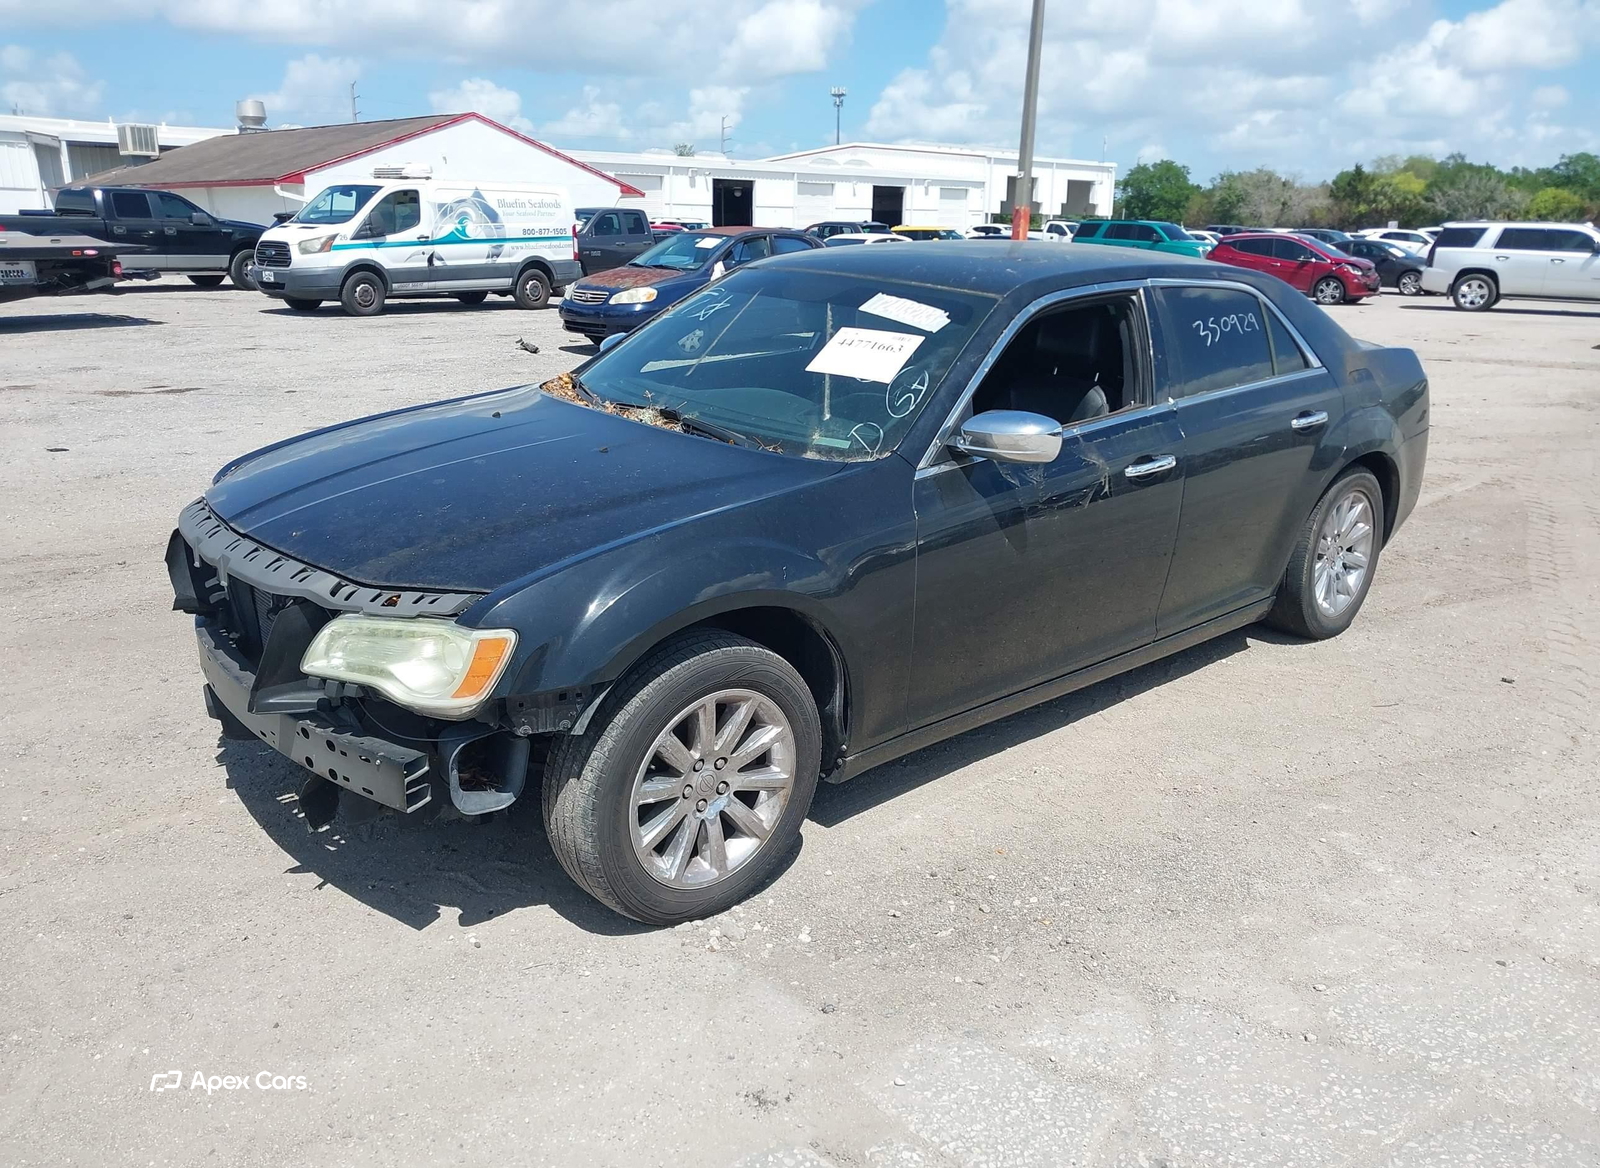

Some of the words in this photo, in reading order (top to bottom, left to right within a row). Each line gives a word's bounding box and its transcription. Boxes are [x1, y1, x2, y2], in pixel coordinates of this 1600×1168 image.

[497, 199, 527, 209] Bluefin
[528, 199, 562, 209] Seafoods
[522, 228, 568, 236] 800-877-1505
[1192, 312, 1260, 347] 350929
[838, 338, 904, 353] 44771663
